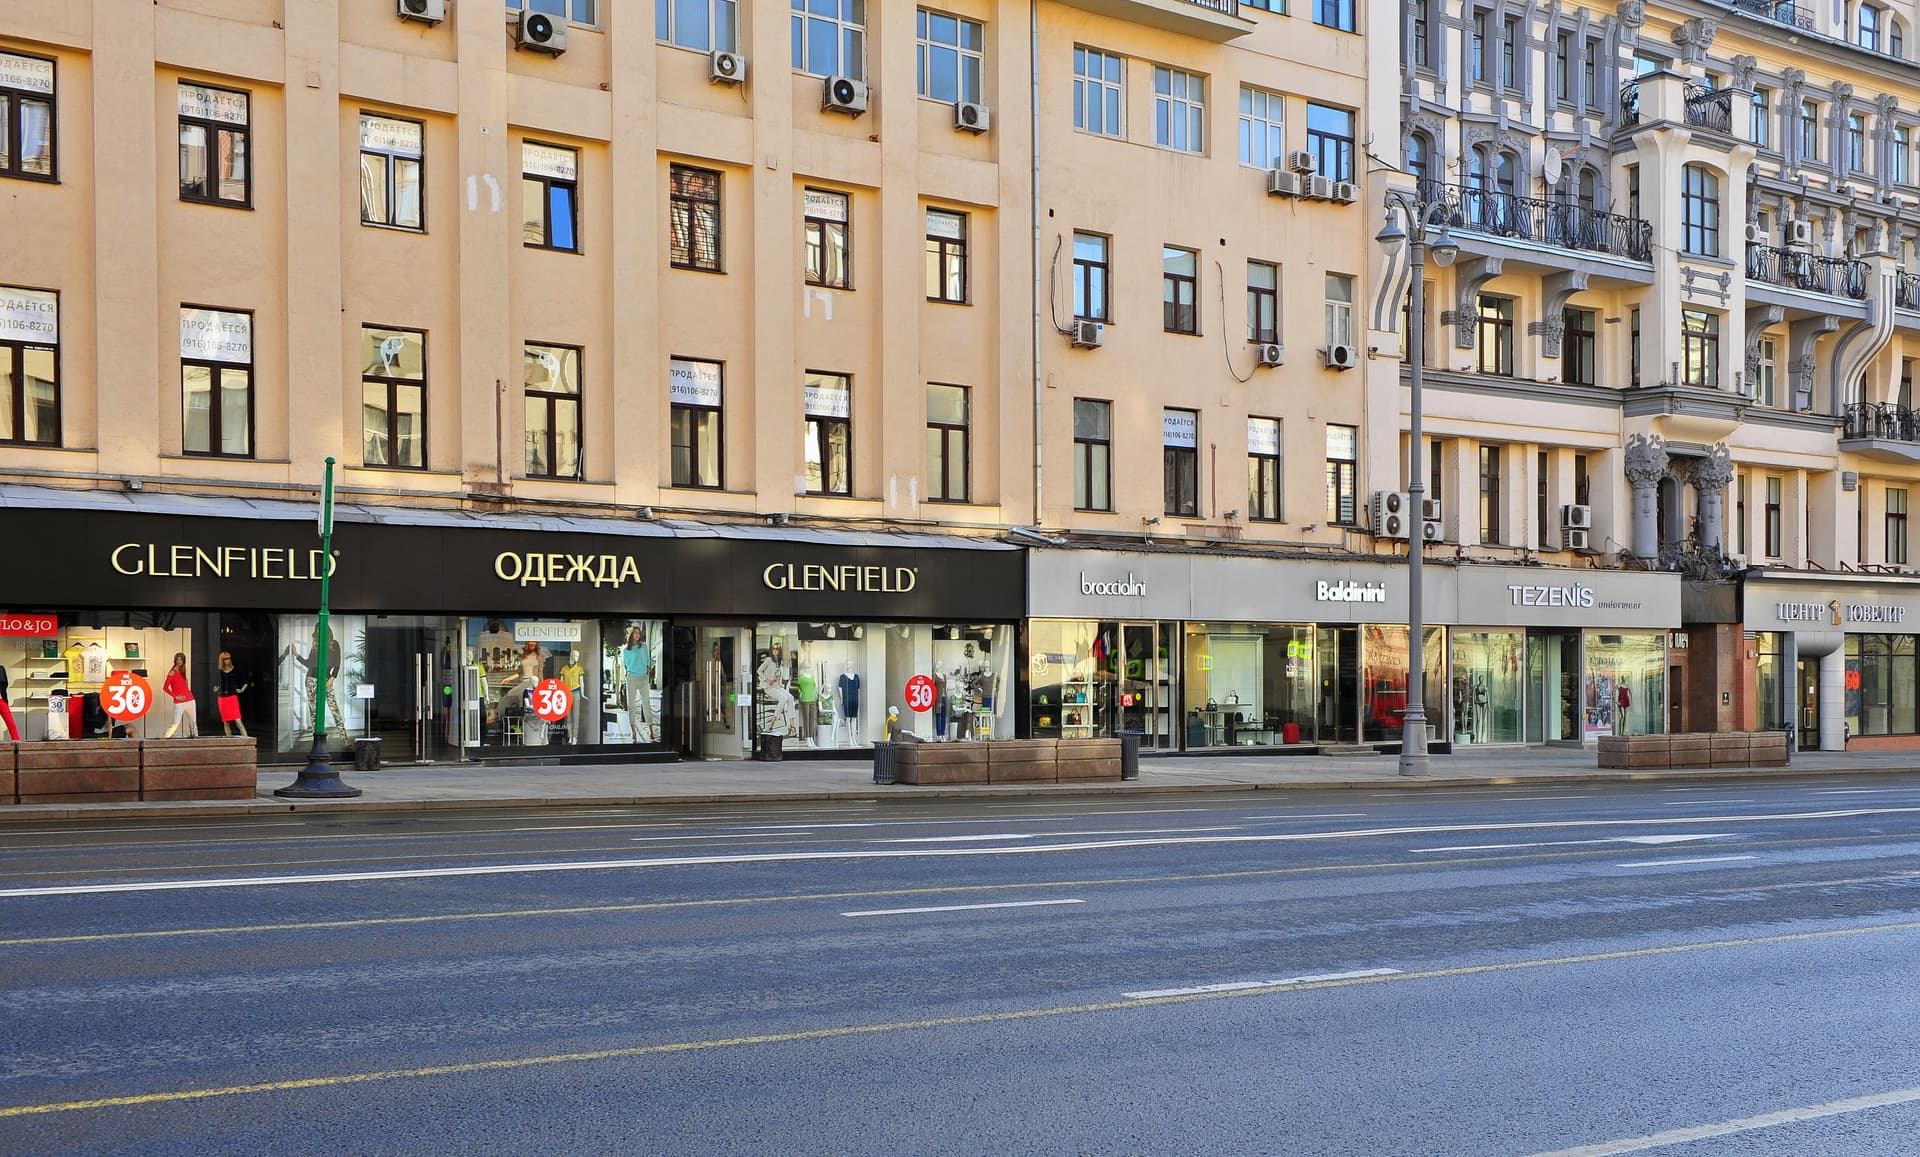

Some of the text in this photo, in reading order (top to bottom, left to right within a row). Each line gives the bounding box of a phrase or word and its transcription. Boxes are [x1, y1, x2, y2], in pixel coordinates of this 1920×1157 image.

[111, 543, 337, 580] GLENFIELD
[494, 551, 642, 589] ОДЕЖДА
[763, 562, 916, 593] GLENFIELD
[1080, 570, 1146, 596] braccialini
[1316, 580, 1386, 603] Baldinini
[1776, 602, 1906, 624] ЦЕНТР ЮВЕЛИР
[517, 626, 578, 638] GLENFIELD
